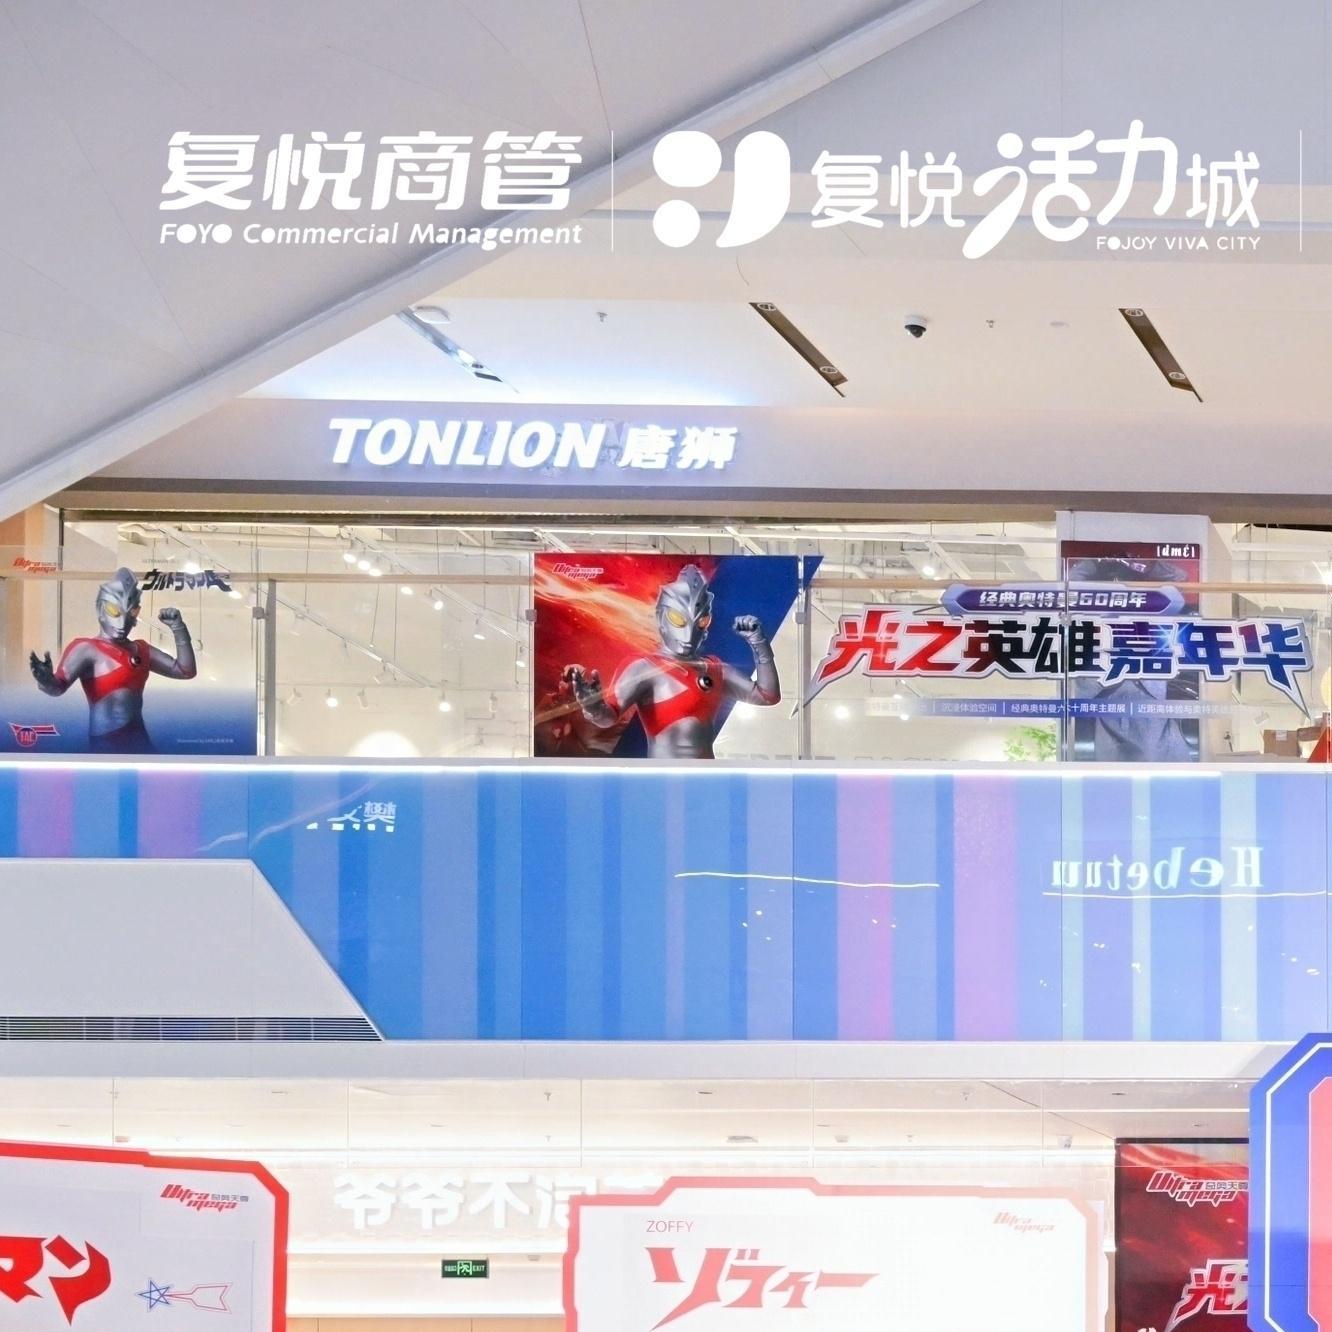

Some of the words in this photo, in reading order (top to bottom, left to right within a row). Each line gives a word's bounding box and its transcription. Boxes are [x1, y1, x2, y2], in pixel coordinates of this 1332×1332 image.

[329, 418, 606, 469] TONLION
[622, 426, 737, 473] 唐狮
[979, 590, 1147, 611] 经典奥特曼60周年
[816, 608, 1308, 692] 光之英雄嘉年华
[646, 1219, 693, 1234] ZOFFY
